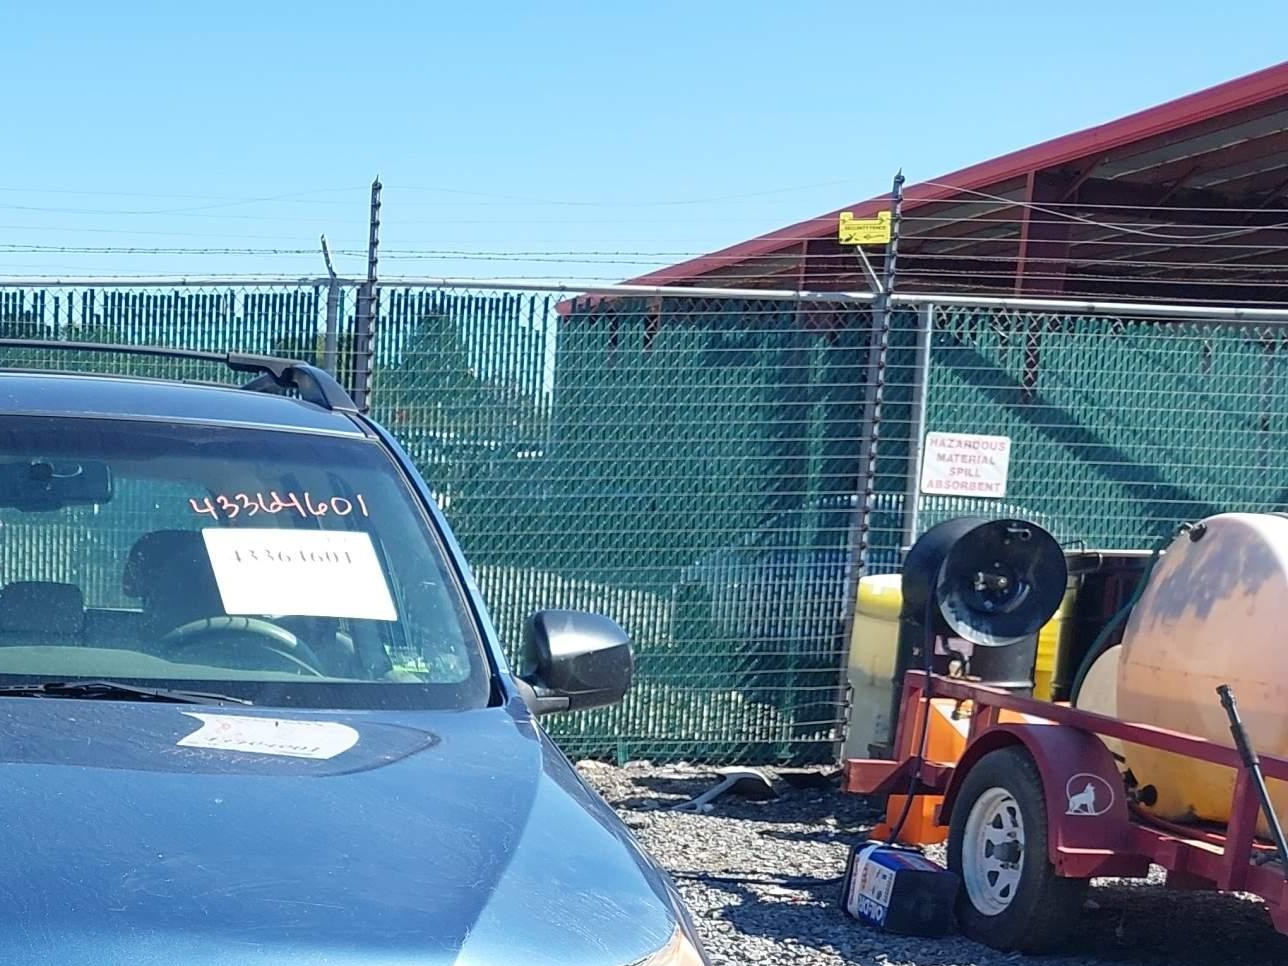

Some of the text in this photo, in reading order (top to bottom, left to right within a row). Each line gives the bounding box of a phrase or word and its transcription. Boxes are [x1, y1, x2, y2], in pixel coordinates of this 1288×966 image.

[929, 438, 1006, 452] HAZARDOUS
[936, 452, 996, 465] MATERIAL
[949, 466, 981, 478] SPILL
[926, 479, 1001, 492] ABSORBENT
[190, 491, 368, 520] 43364601
